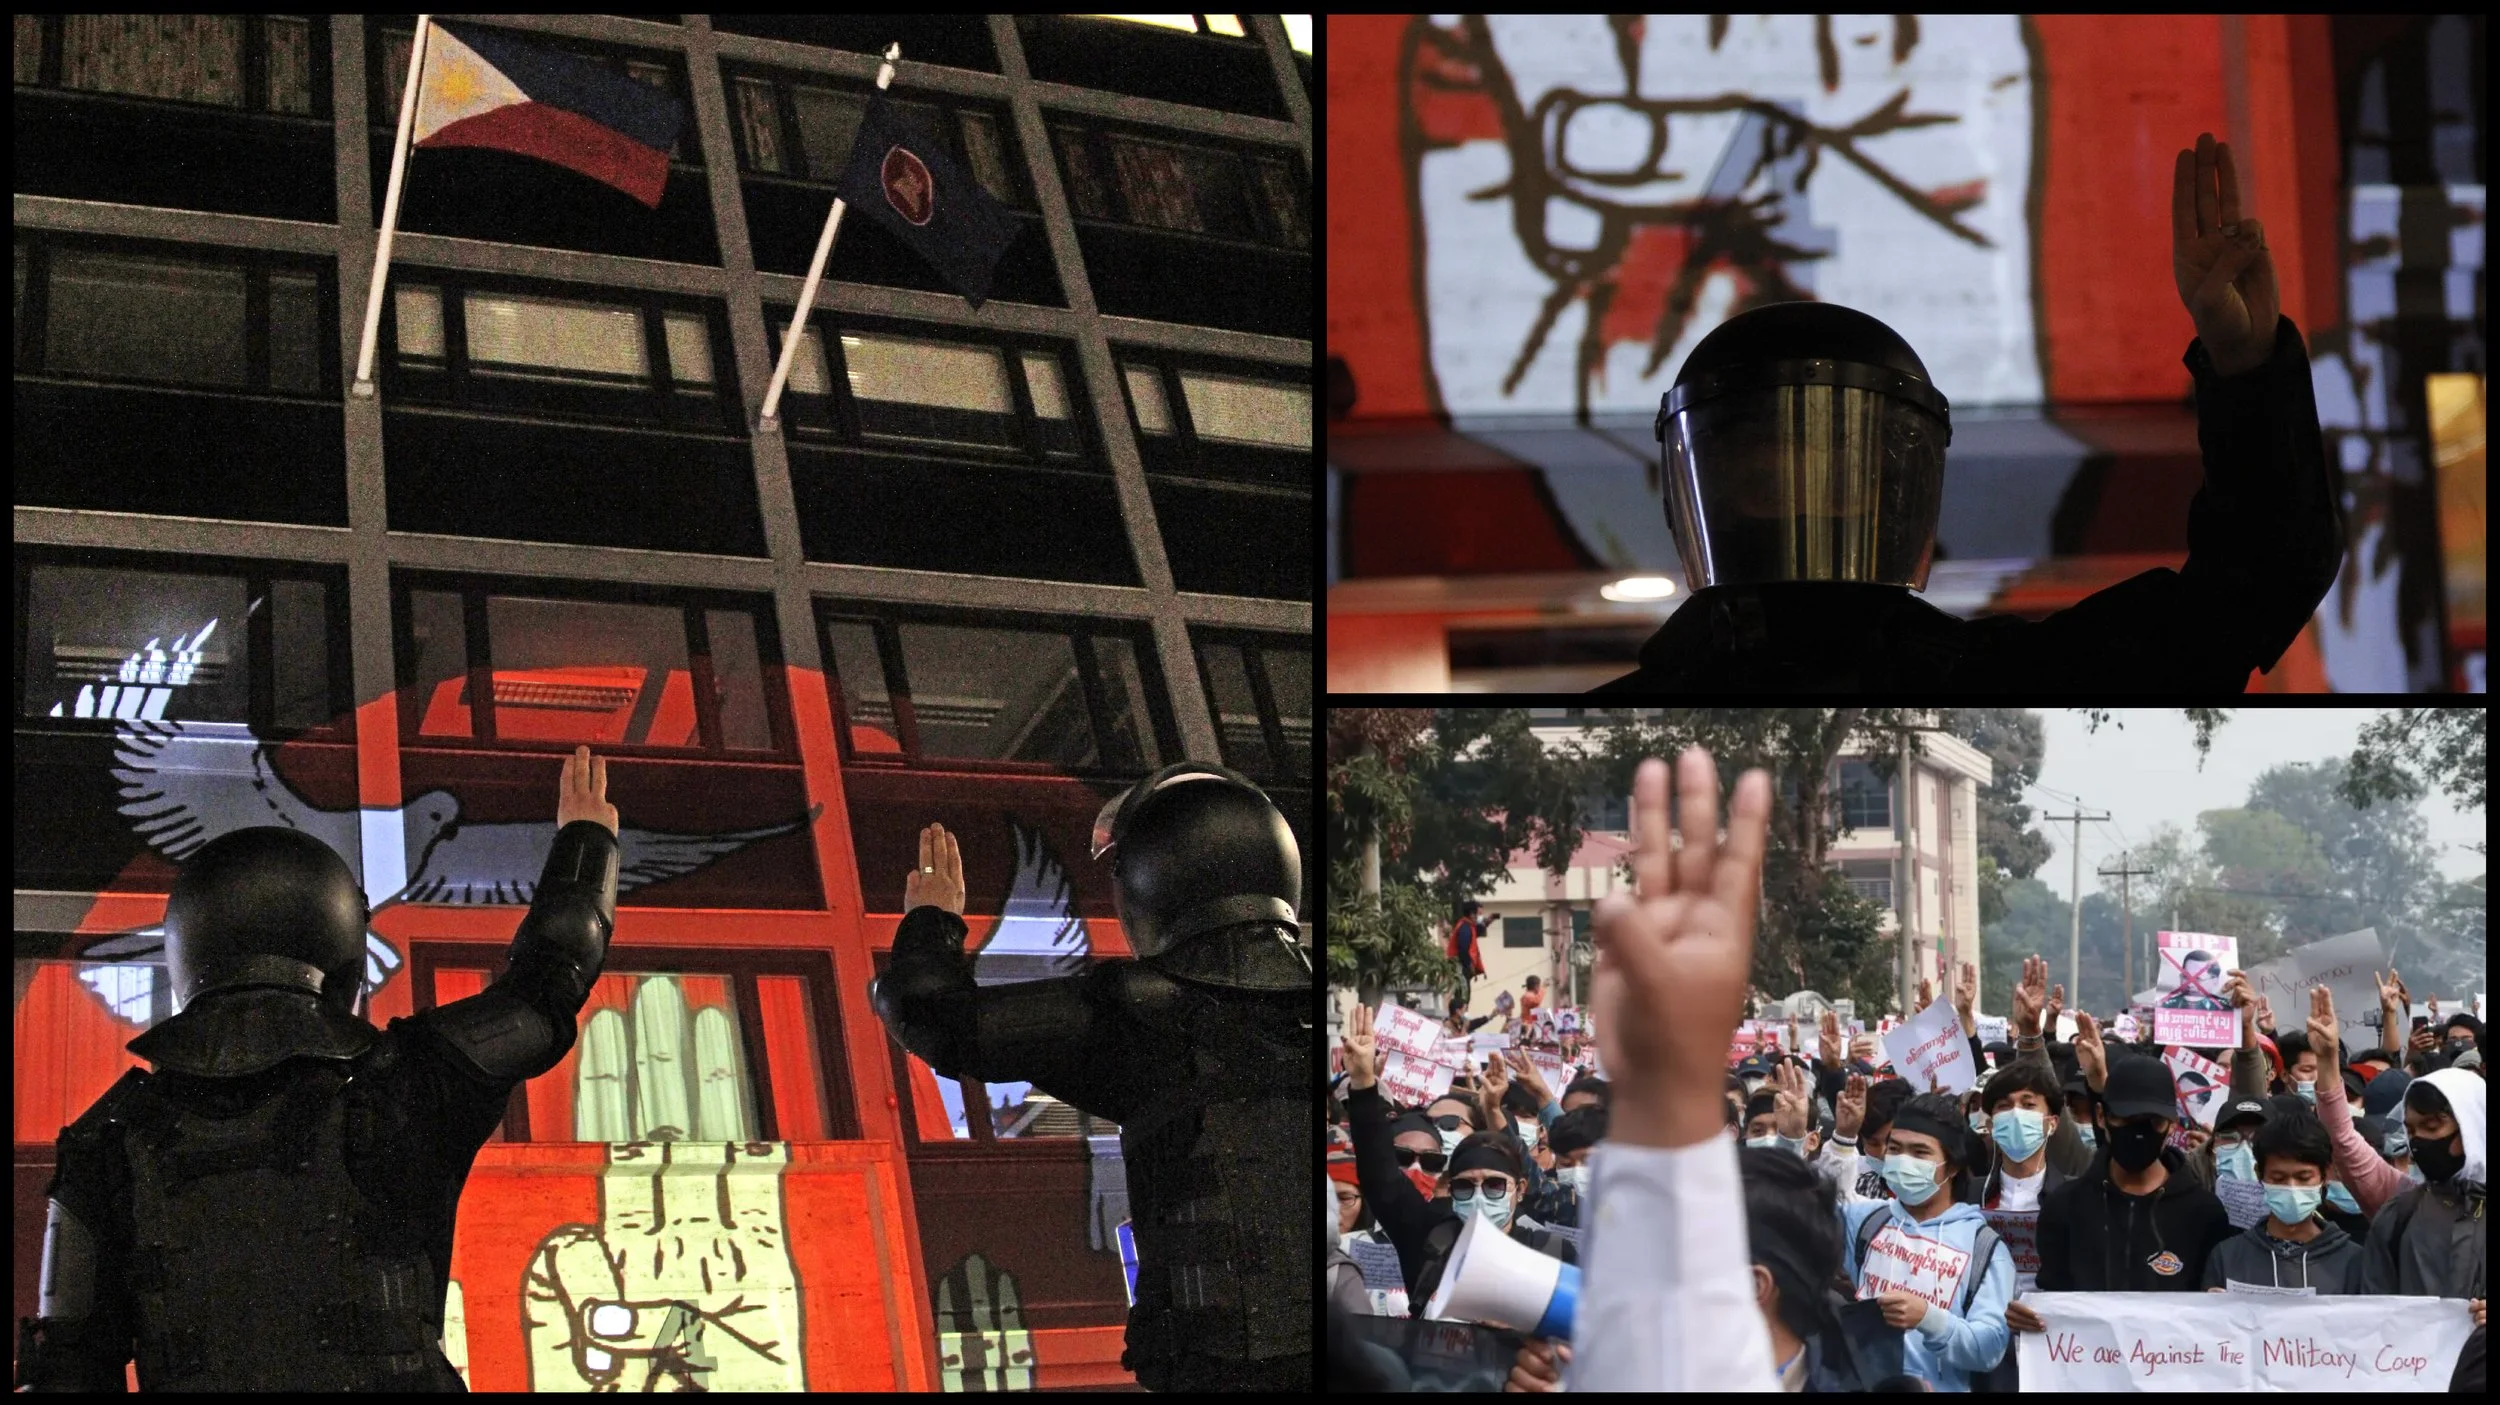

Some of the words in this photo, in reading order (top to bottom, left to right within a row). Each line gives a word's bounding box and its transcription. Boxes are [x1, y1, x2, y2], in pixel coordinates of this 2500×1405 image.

[2169, 932, 2221, 951] RIP
[2260, 963, 2353, 1009] Myanmar
[2174, 1046, 2226, 1079] RIP
[2045, 1332, 2084, 1363] We
[2093, 1345, 2121, 1364] are
[2130, 1338, 2205, 1376] Against
[2217, 1340, 2245, 1365] The
[2263, 1336, 2357, 1379] Military
[2375, 1344, 2428, 1377] Coup
